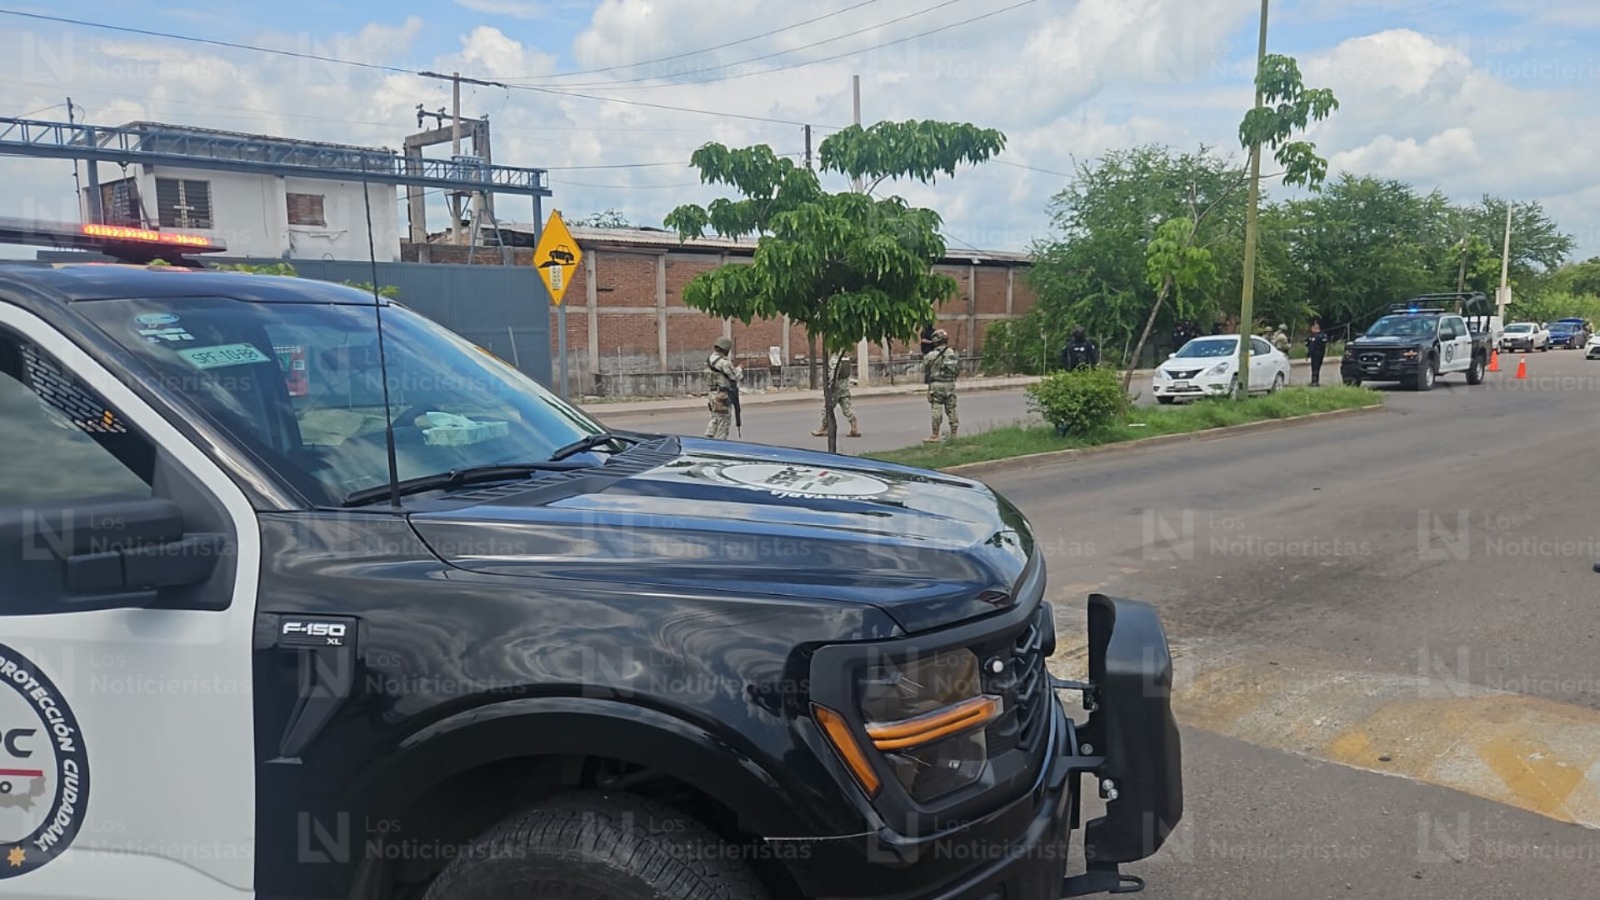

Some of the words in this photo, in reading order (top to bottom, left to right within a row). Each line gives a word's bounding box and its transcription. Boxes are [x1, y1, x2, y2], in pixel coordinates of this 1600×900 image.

[283, 622, 346, 636] F-150
[326, 637, 342, 646] XL
[0, 728, 37, 758] C
[33, 758, 79, 852] CIUDADANA
